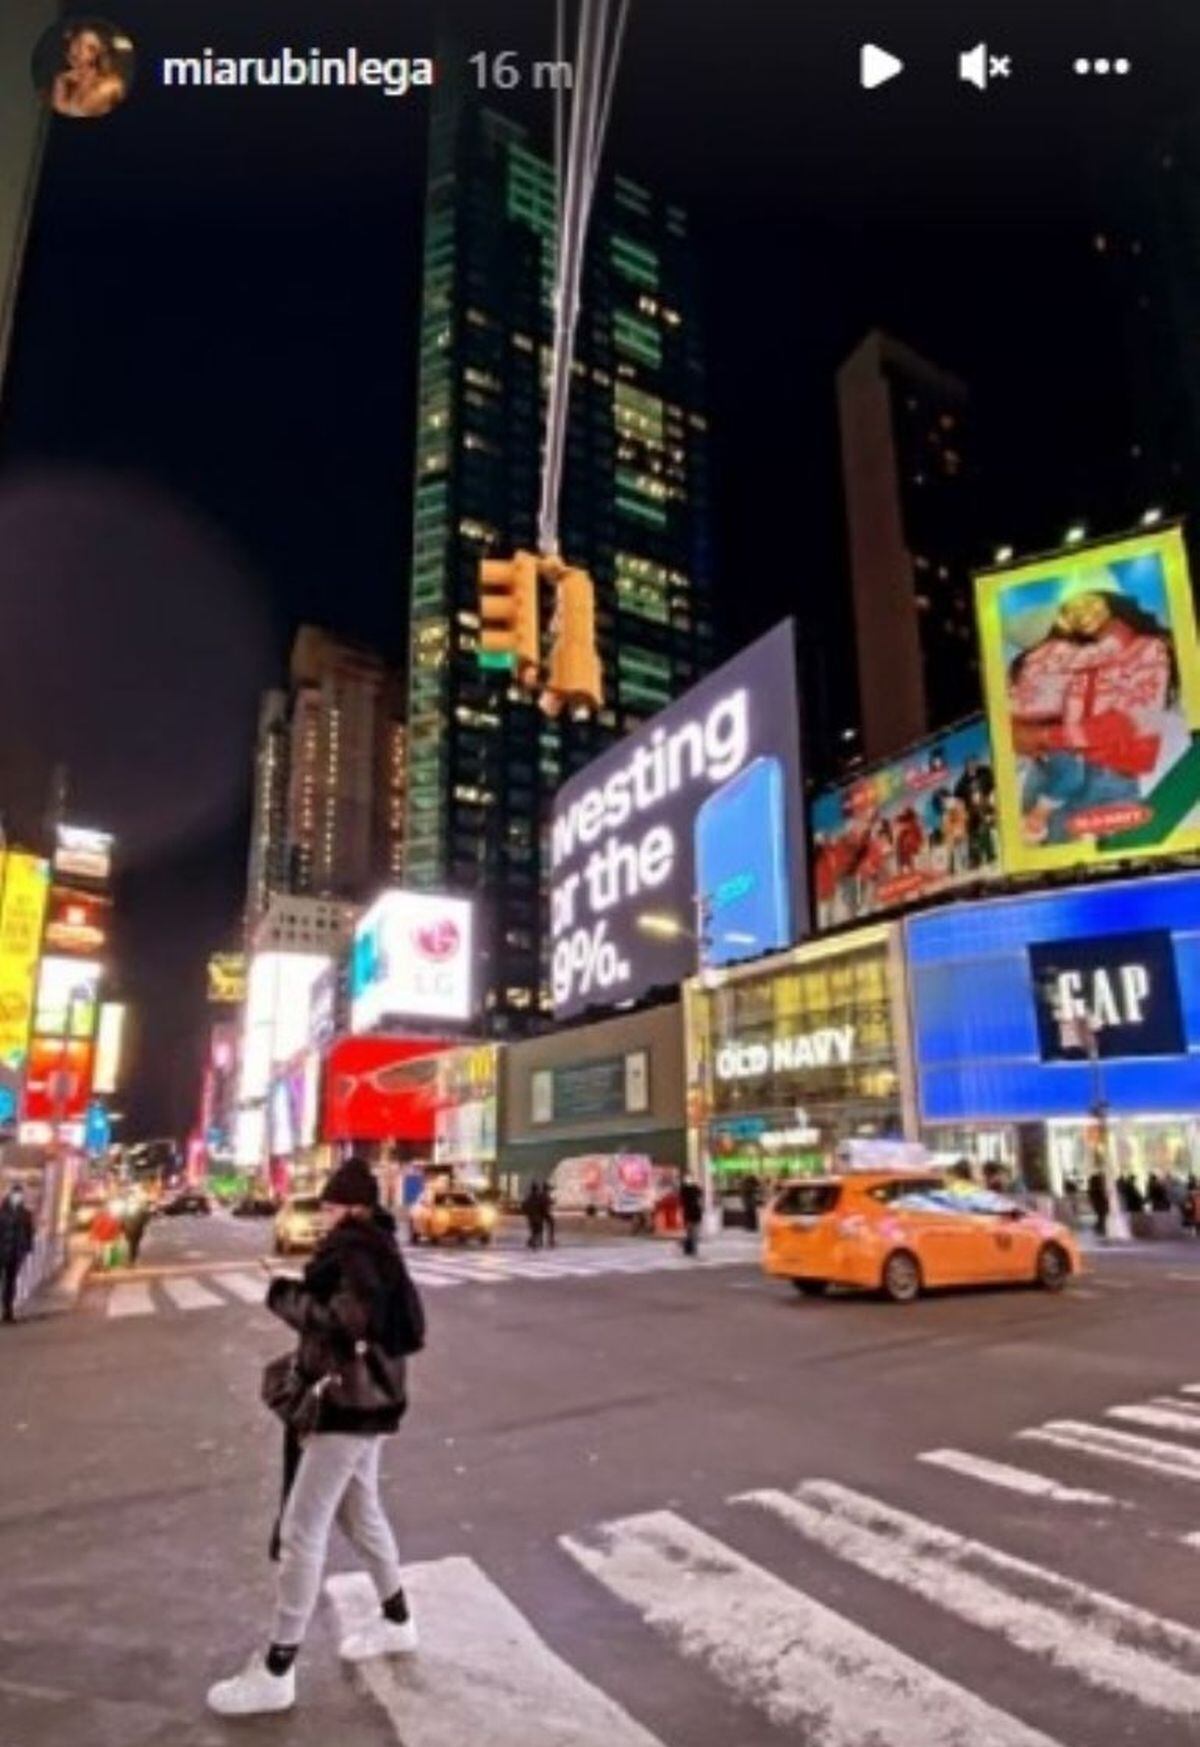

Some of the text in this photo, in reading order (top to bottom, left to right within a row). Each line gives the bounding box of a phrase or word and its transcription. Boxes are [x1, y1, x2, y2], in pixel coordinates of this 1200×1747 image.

[585, 824, 675, 912] the
[1056, 963, 1150, 1026] GAP
[716, 1023, 855, 1079] OLD NAVY
